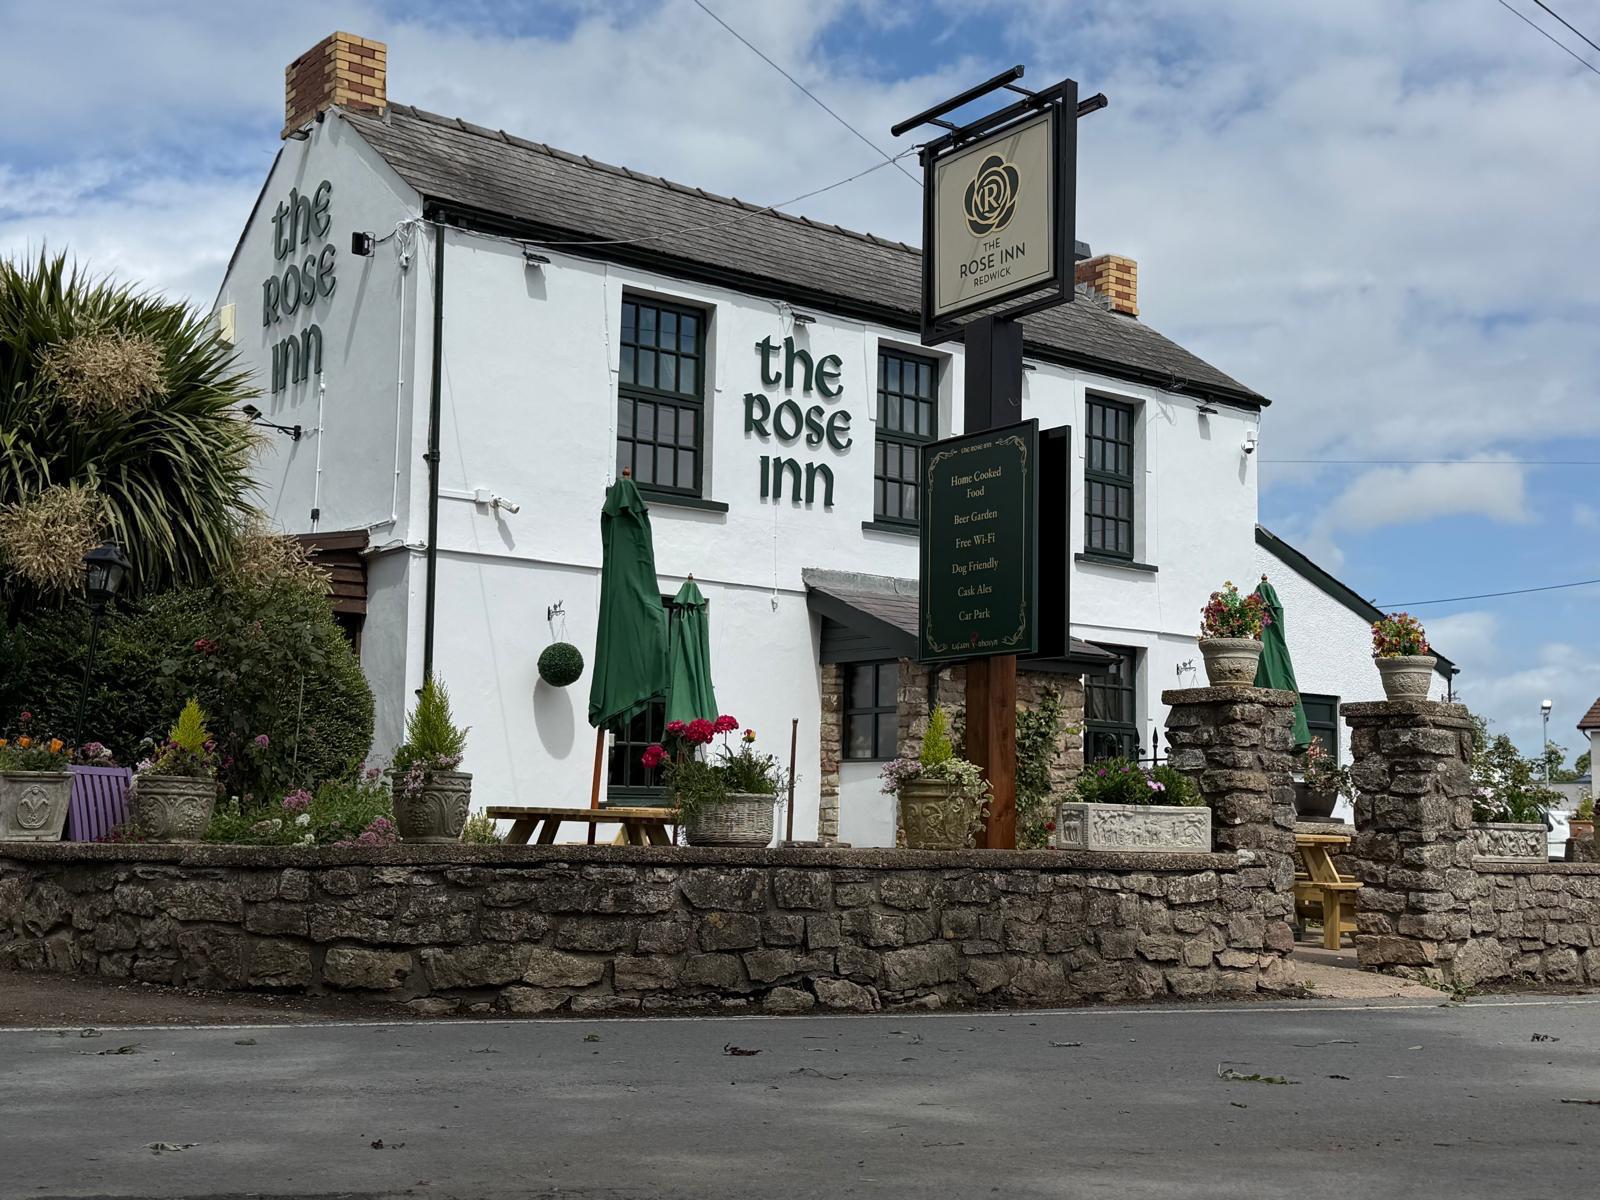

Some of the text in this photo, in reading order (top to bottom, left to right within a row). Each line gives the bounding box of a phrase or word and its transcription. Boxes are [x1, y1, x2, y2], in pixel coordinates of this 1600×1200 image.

[982, 184, 1000, 213] R
[271, 180, 332, 261] the
[983, 237, 1001, 252] THE
[960, 242, 1026, 279] ROSE INN
[973, 266, 1011, 288] REDWICK
[755, 335, 844, 398] the
[951, 466, 1002, 487] Home Cooked
[967, 486, 985, 499] Food
[954, 508, 998, 525] Beer Garden
[955, 532, 996, 549] Free Wi-Fi
[952, 557, 999, 576] Dog Friendly
[957, 584, 993, 597] Cask Ales
[959, 608, 991, 621] Car Park
